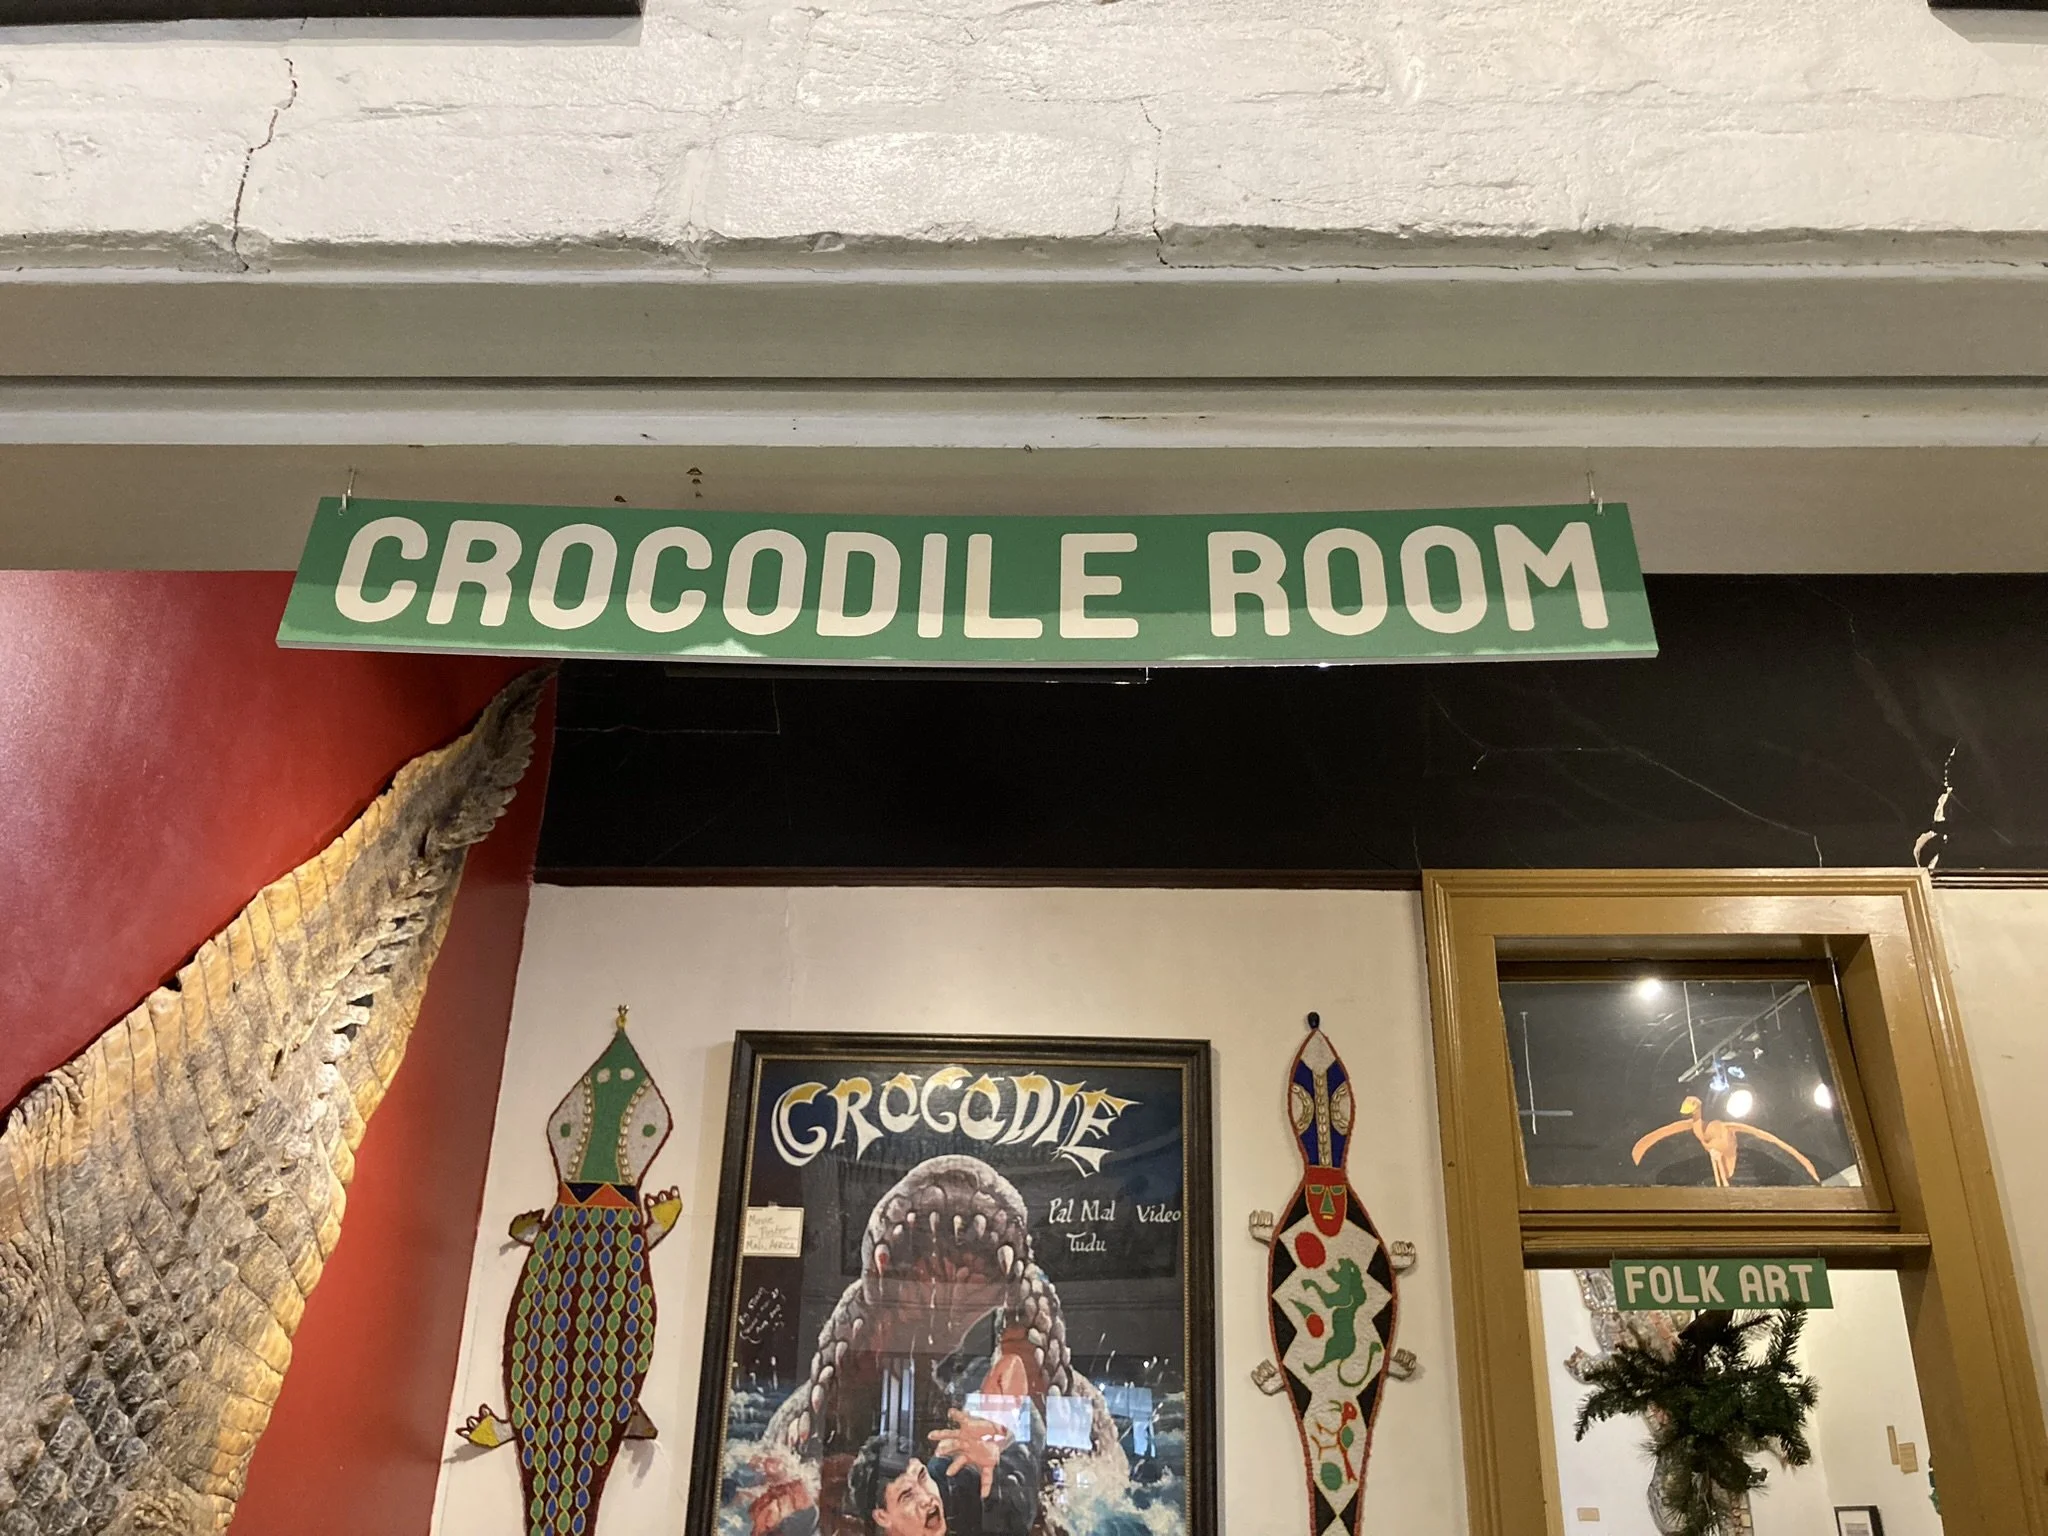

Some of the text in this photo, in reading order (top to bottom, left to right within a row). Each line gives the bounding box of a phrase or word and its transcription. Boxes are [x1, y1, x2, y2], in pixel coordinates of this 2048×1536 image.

[334, 516, 1609, 639] CROCODILE ROOM
[1049, 1197, 1074, 1224] Pal
[1136, 1203, 1181, 1223] Video
[1066, 1231, 1107, 1252] Tudu
[1624, 1264, 1813, 1304] FOLK ART
